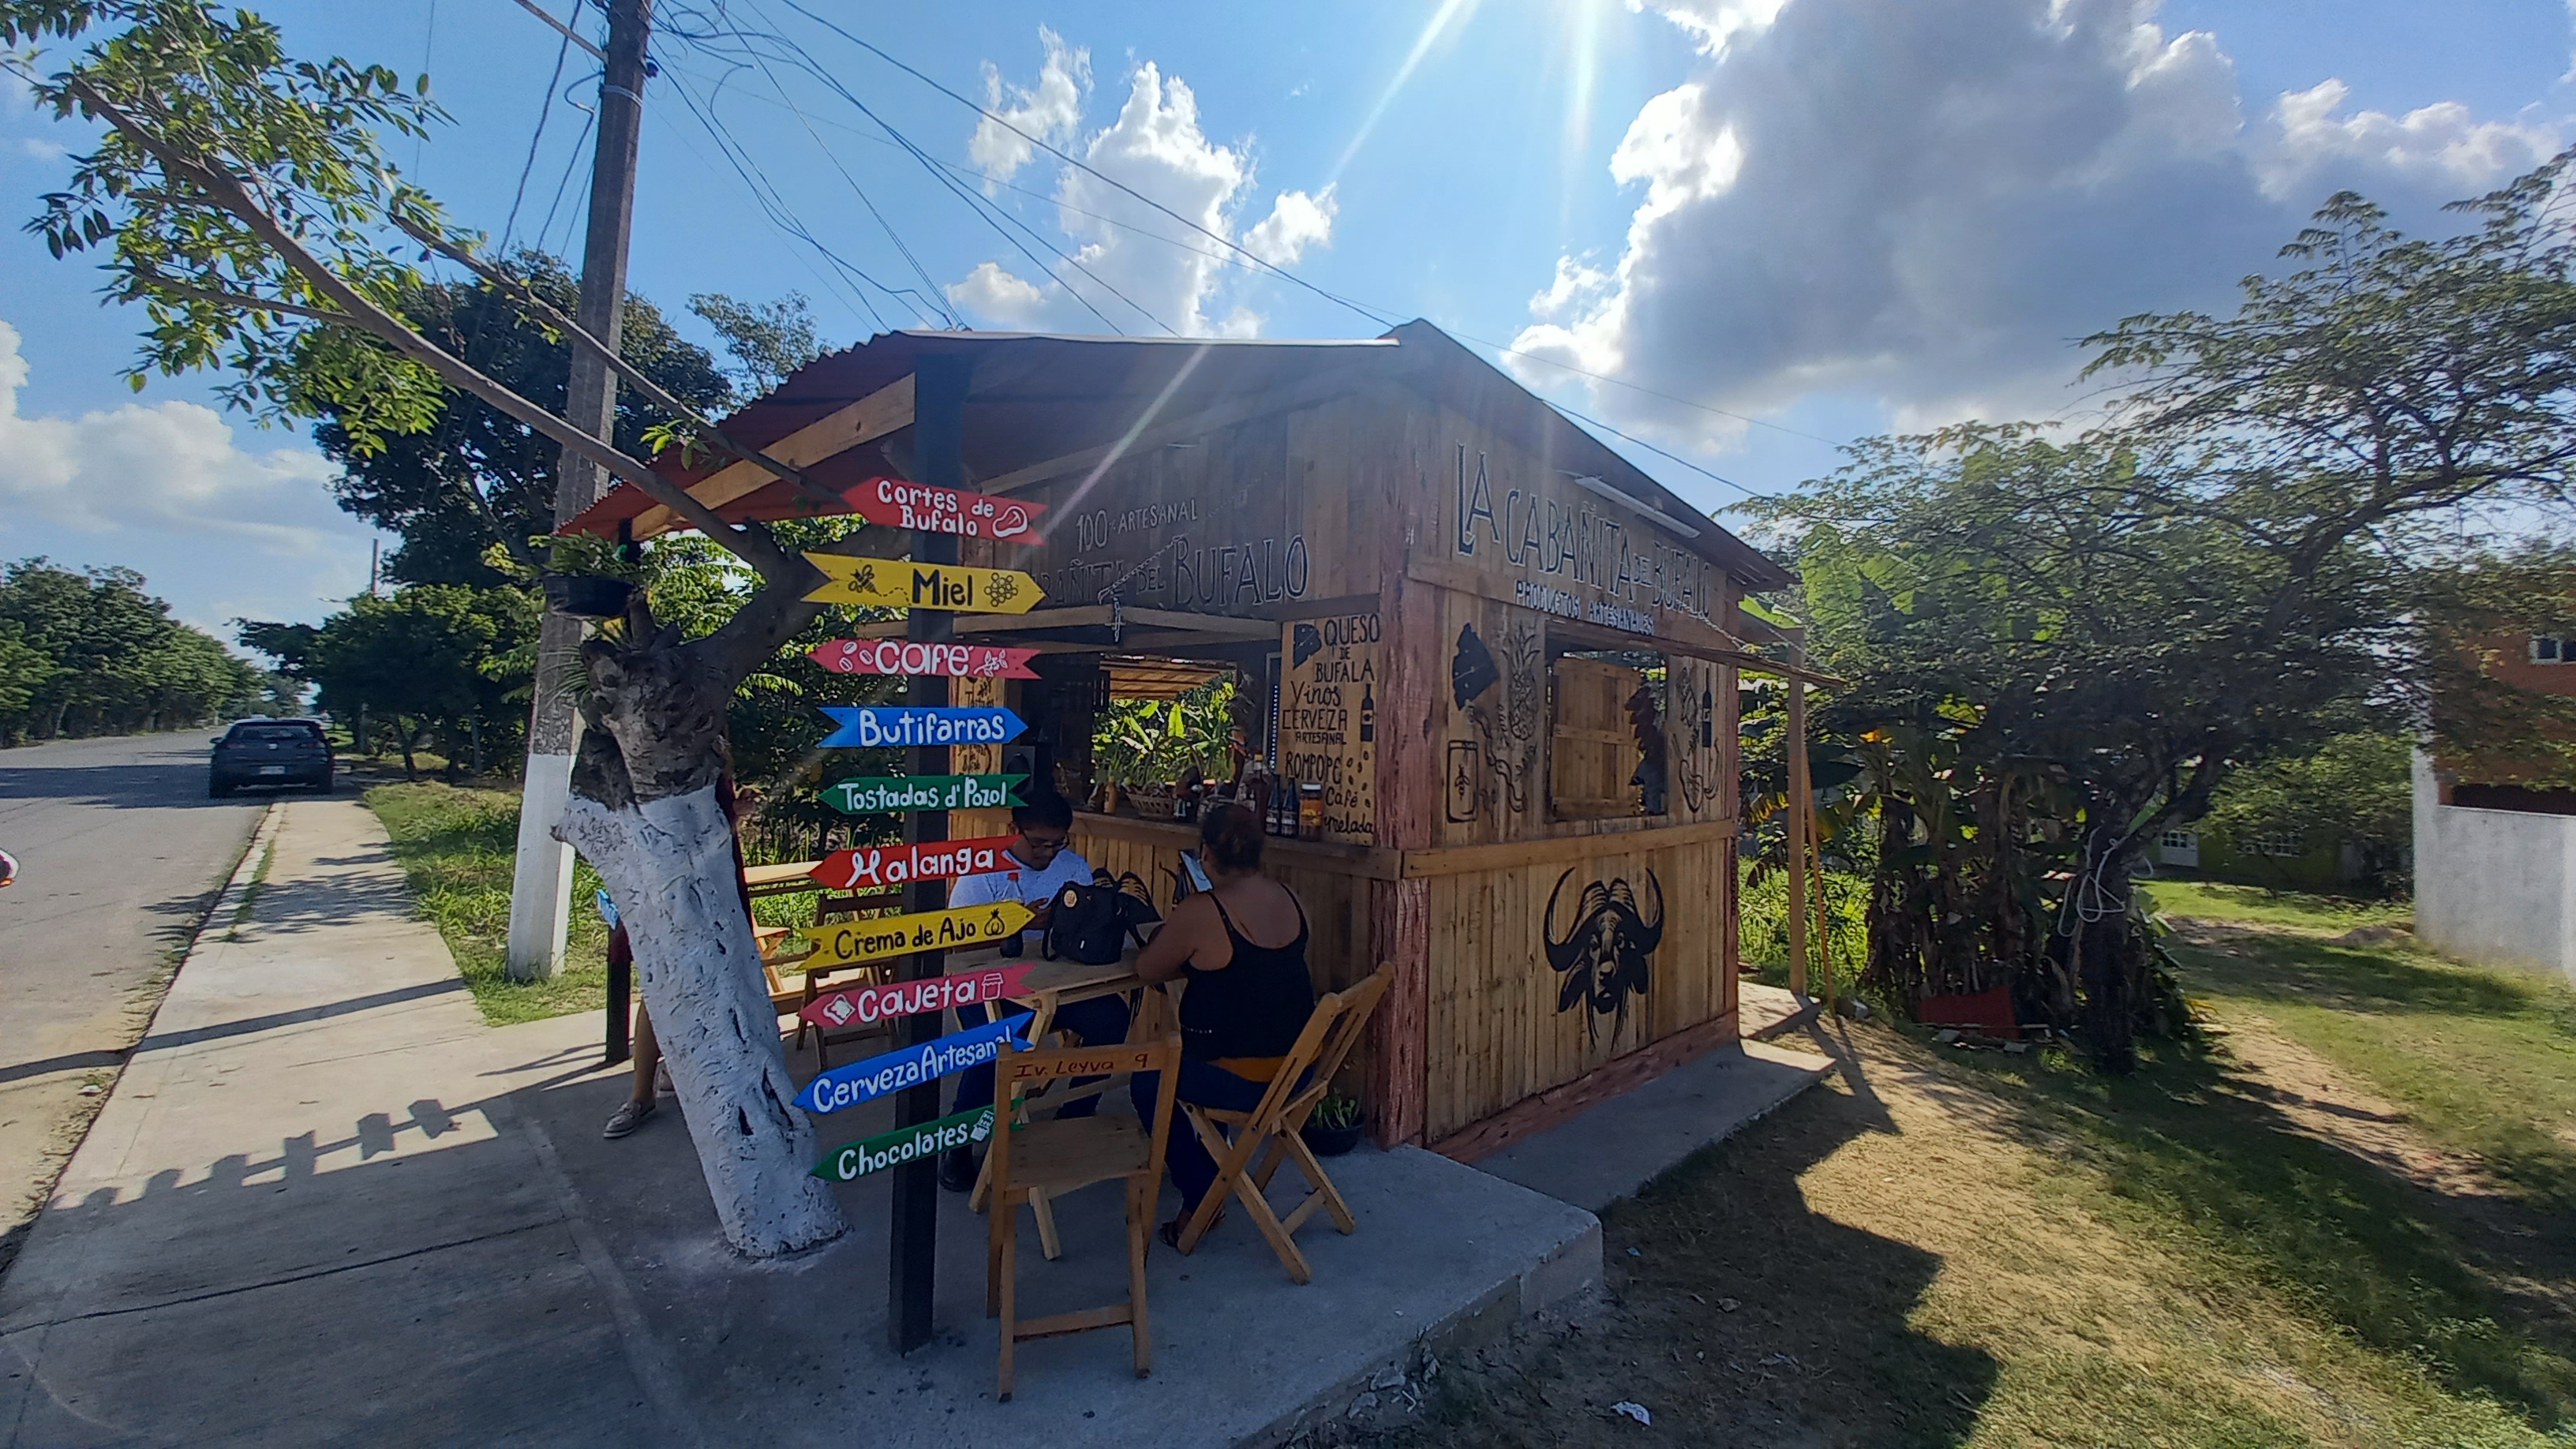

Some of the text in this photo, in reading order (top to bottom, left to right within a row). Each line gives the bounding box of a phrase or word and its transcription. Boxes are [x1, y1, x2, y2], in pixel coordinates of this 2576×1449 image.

[877, 480, 995, 518] Cortes de
[1455, 438, 1500, 557] LA
[899, 504, 979, 537] Bufalo
[1118, 499, 1198, 534] ARTESANAL
[912, 568, 974, 607] Miel
[1136, 565, 1166, 595] DEL
[1173, 534, 1310, 607] BUFALO
[1324, 613, 1380, 647] QUESO
[874, 641, 975, 675] Café
[1339, 646, 1351, 660] DE
[1315, 658, 1376, 683] BUFALA
[1290, 680, 1342, 707] Vinos
[859, 710, 1005, 747] Butifarras
[1282, 709, 1348, 732] CERVEZA
[1295, 731, 1348, 745] ARTESANAL
[1285, 751, 1342, 784] ROMPOPE
[837, 783, 939, 811] Tostadas
[1325, 786, 1358, 808] Café
[844, 845, 994, 888] Malanga
[833, 916, 976, 959] Crema de Ajo
[921, 1026, 1012, 1082] Artesanl
[837, 1121, 969, 1181] Chocolates
